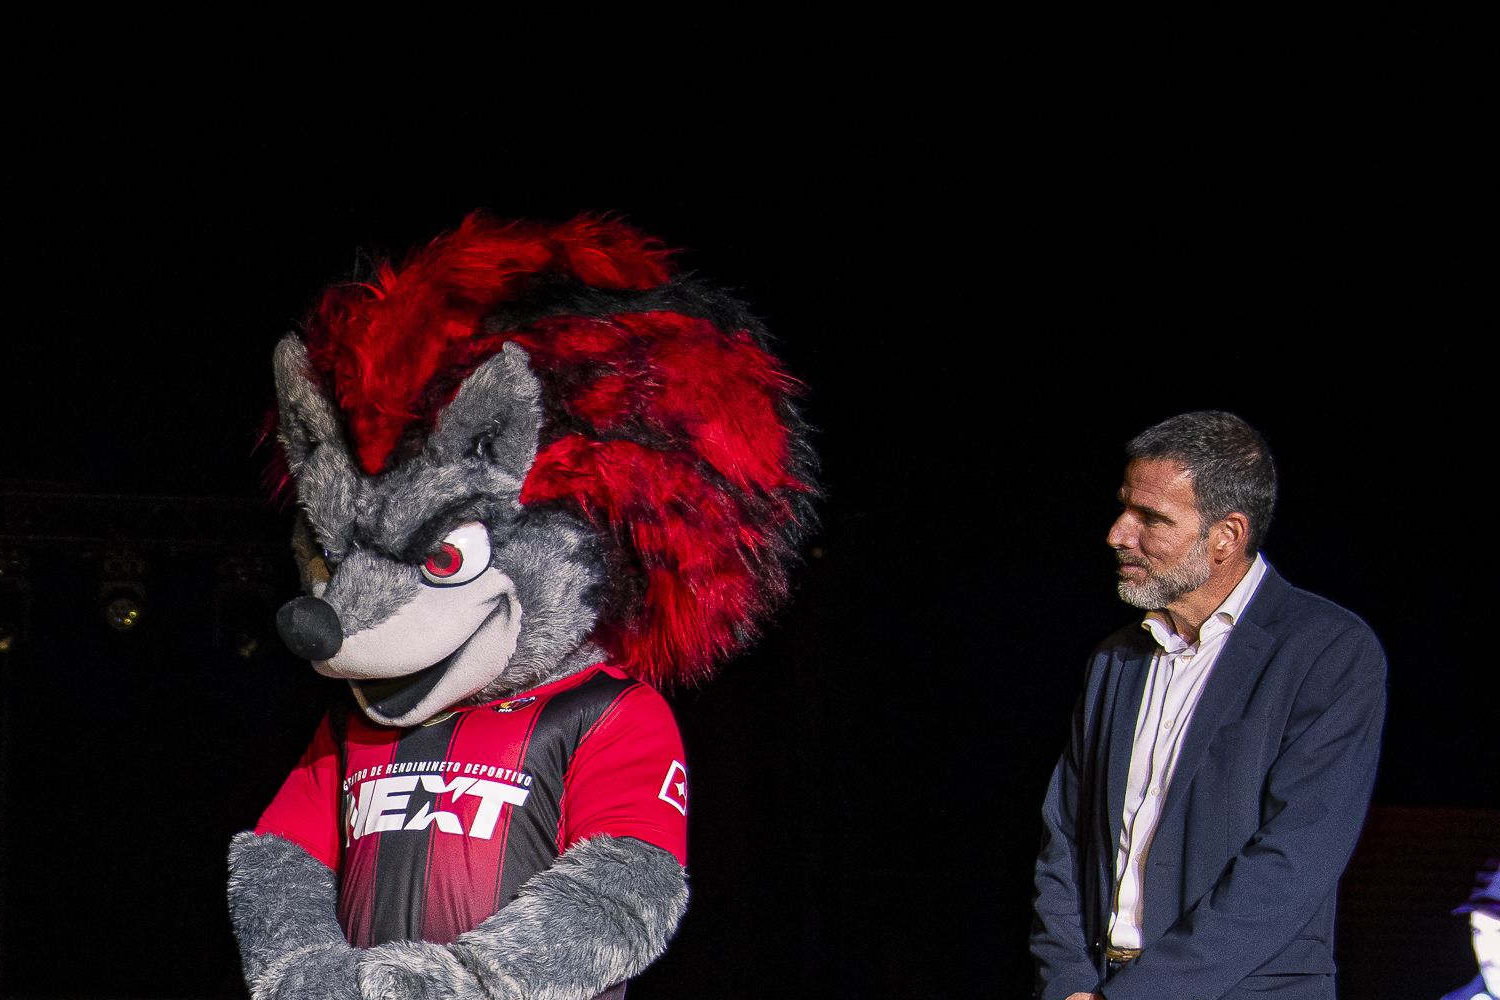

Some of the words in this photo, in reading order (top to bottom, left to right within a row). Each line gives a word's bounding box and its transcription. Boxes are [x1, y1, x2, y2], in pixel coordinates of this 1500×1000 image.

[370, 765, 384, 777] DE
[386, 761, 461, 775] RENDIMINETO
[464, 763, 533, 787] DEPORTIVO
[346, 775, 530, 848] NEXT
